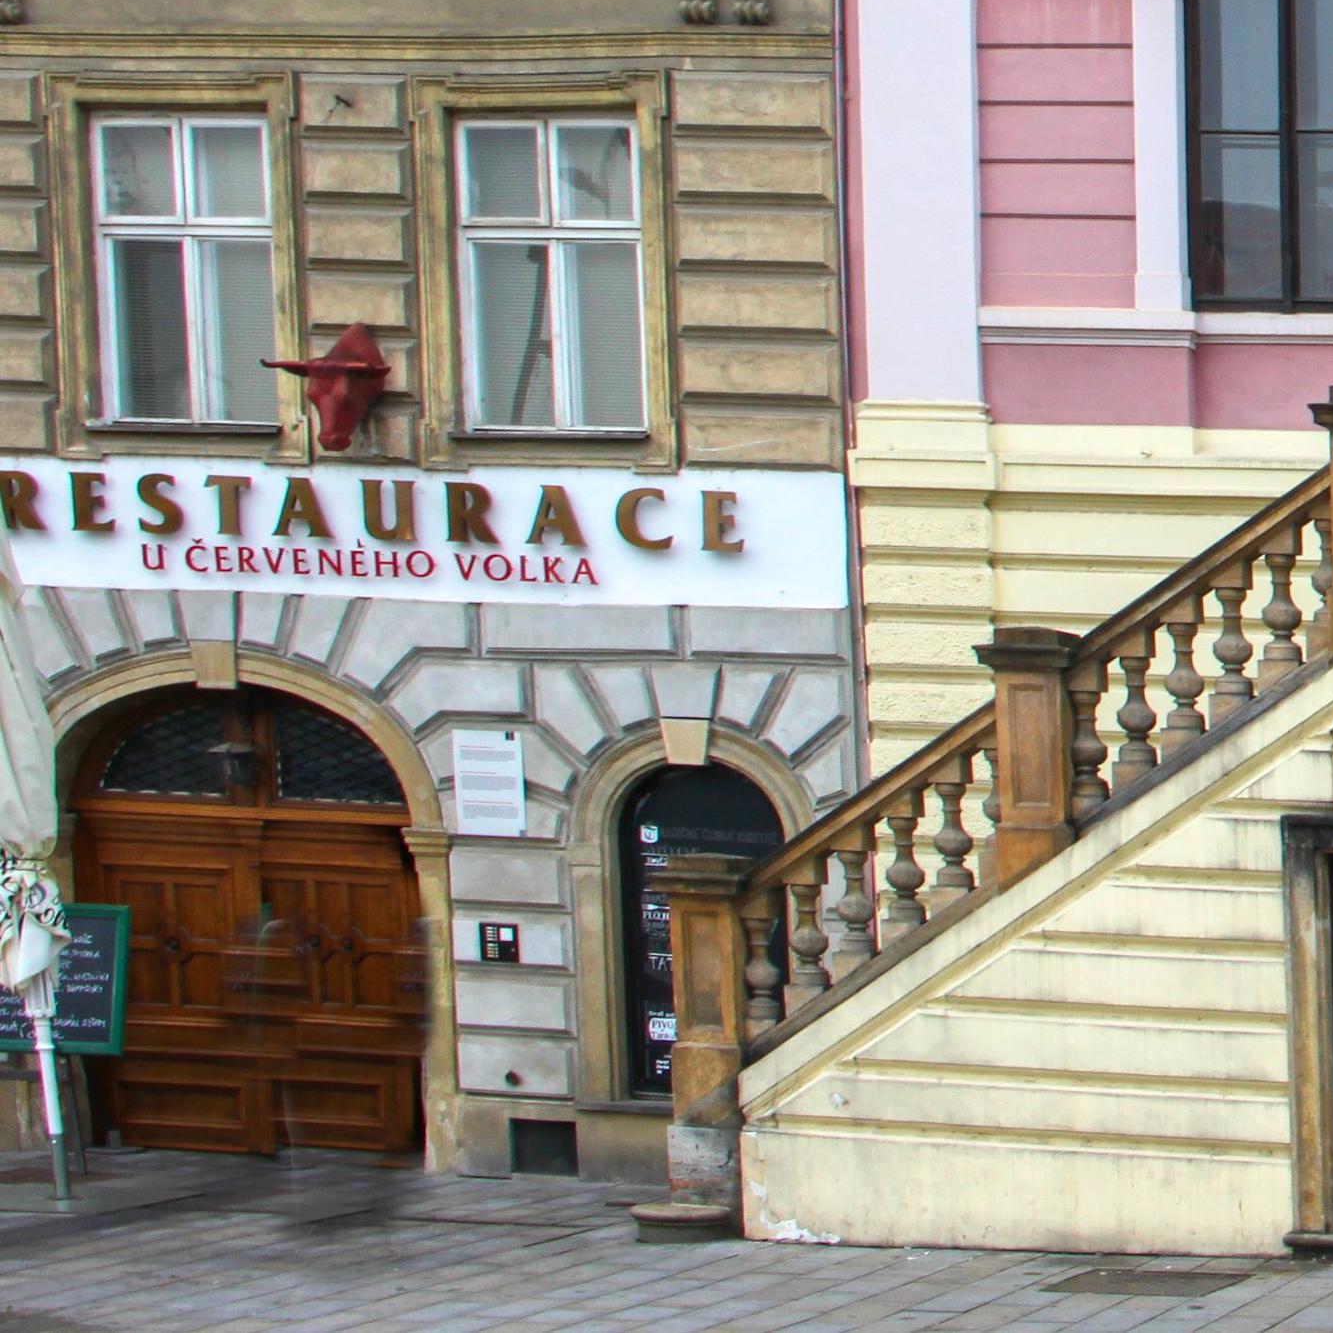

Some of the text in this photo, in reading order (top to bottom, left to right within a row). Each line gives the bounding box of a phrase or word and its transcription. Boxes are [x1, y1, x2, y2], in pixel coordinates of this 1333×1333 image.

[0, 470, 746, 554] RESTAURACE
[141, 538, 599, 585] U ČERVENÉHO VOLKA
